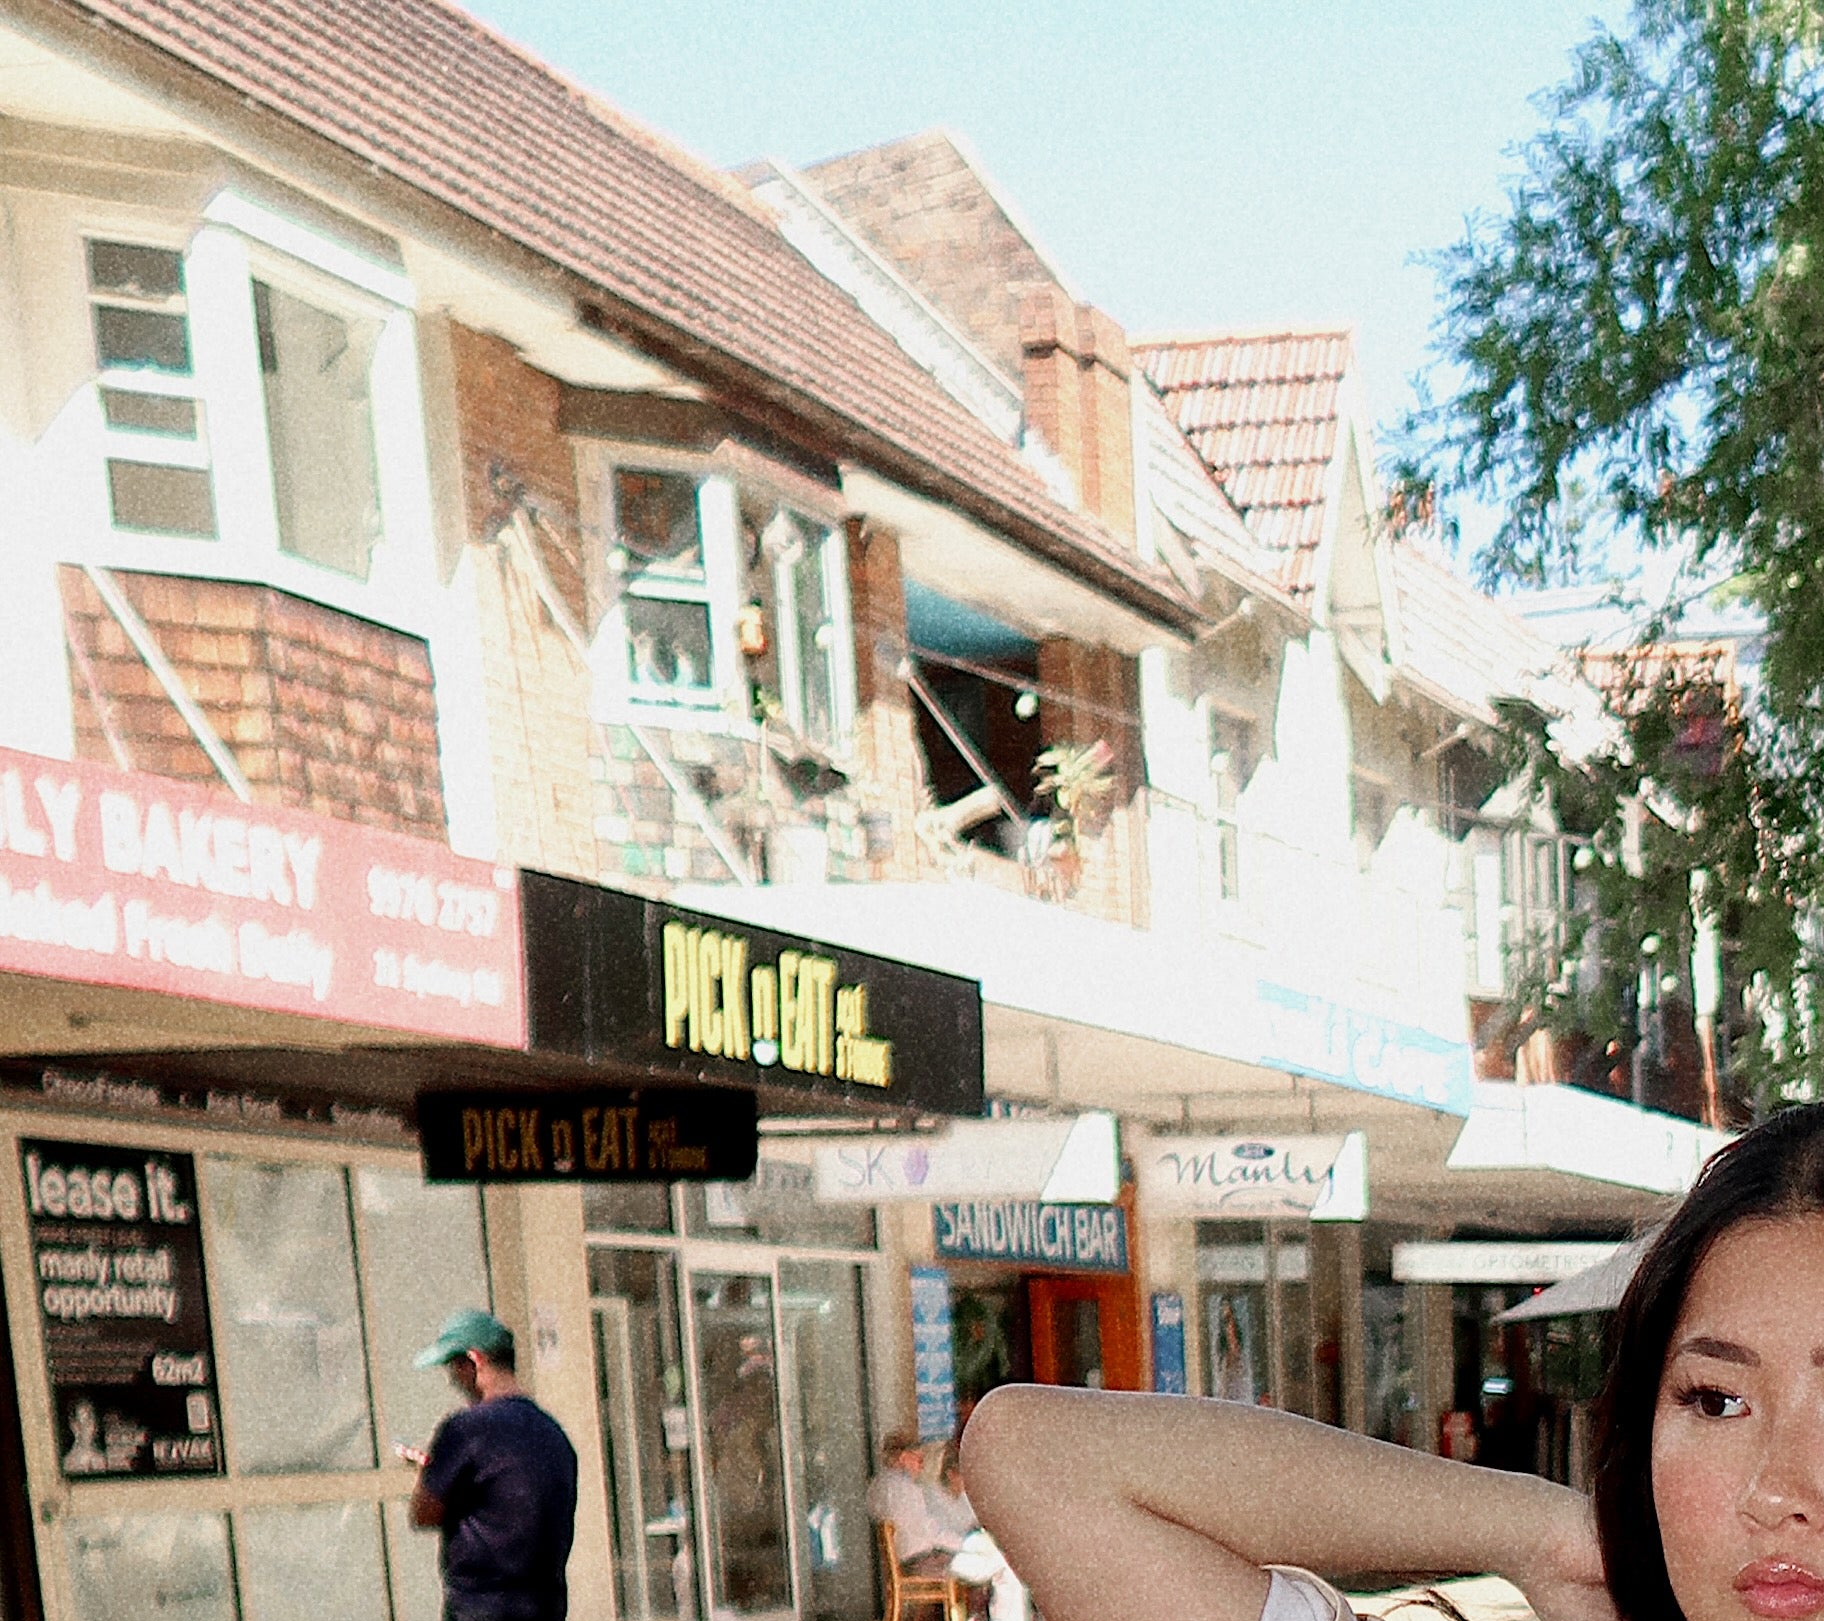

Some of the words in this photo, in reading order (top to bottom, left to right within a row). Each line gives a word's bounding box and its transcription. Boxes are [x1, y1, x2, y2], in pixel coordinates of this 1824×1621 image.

[99, 788, 321, 910] BAKERY
[663, 920, 749, 1062] PICK
[751, 963, 778, 1040] n
[779, 950, 838, 1077] EAT
[462, 1106, 543, 1172] PICK
[582, 1105, 640, 1172] EAT
[27, 1152, 141, 1220] lease
[40, 1246, 110, 1285] manly
[113, 1245, 172, 1281] retail
[938, 1203, 1070, 1258] SANDWICH
[1074, 1207, 1119, 1264] BAR
[43, 1285, 180, 1324] opportunity
